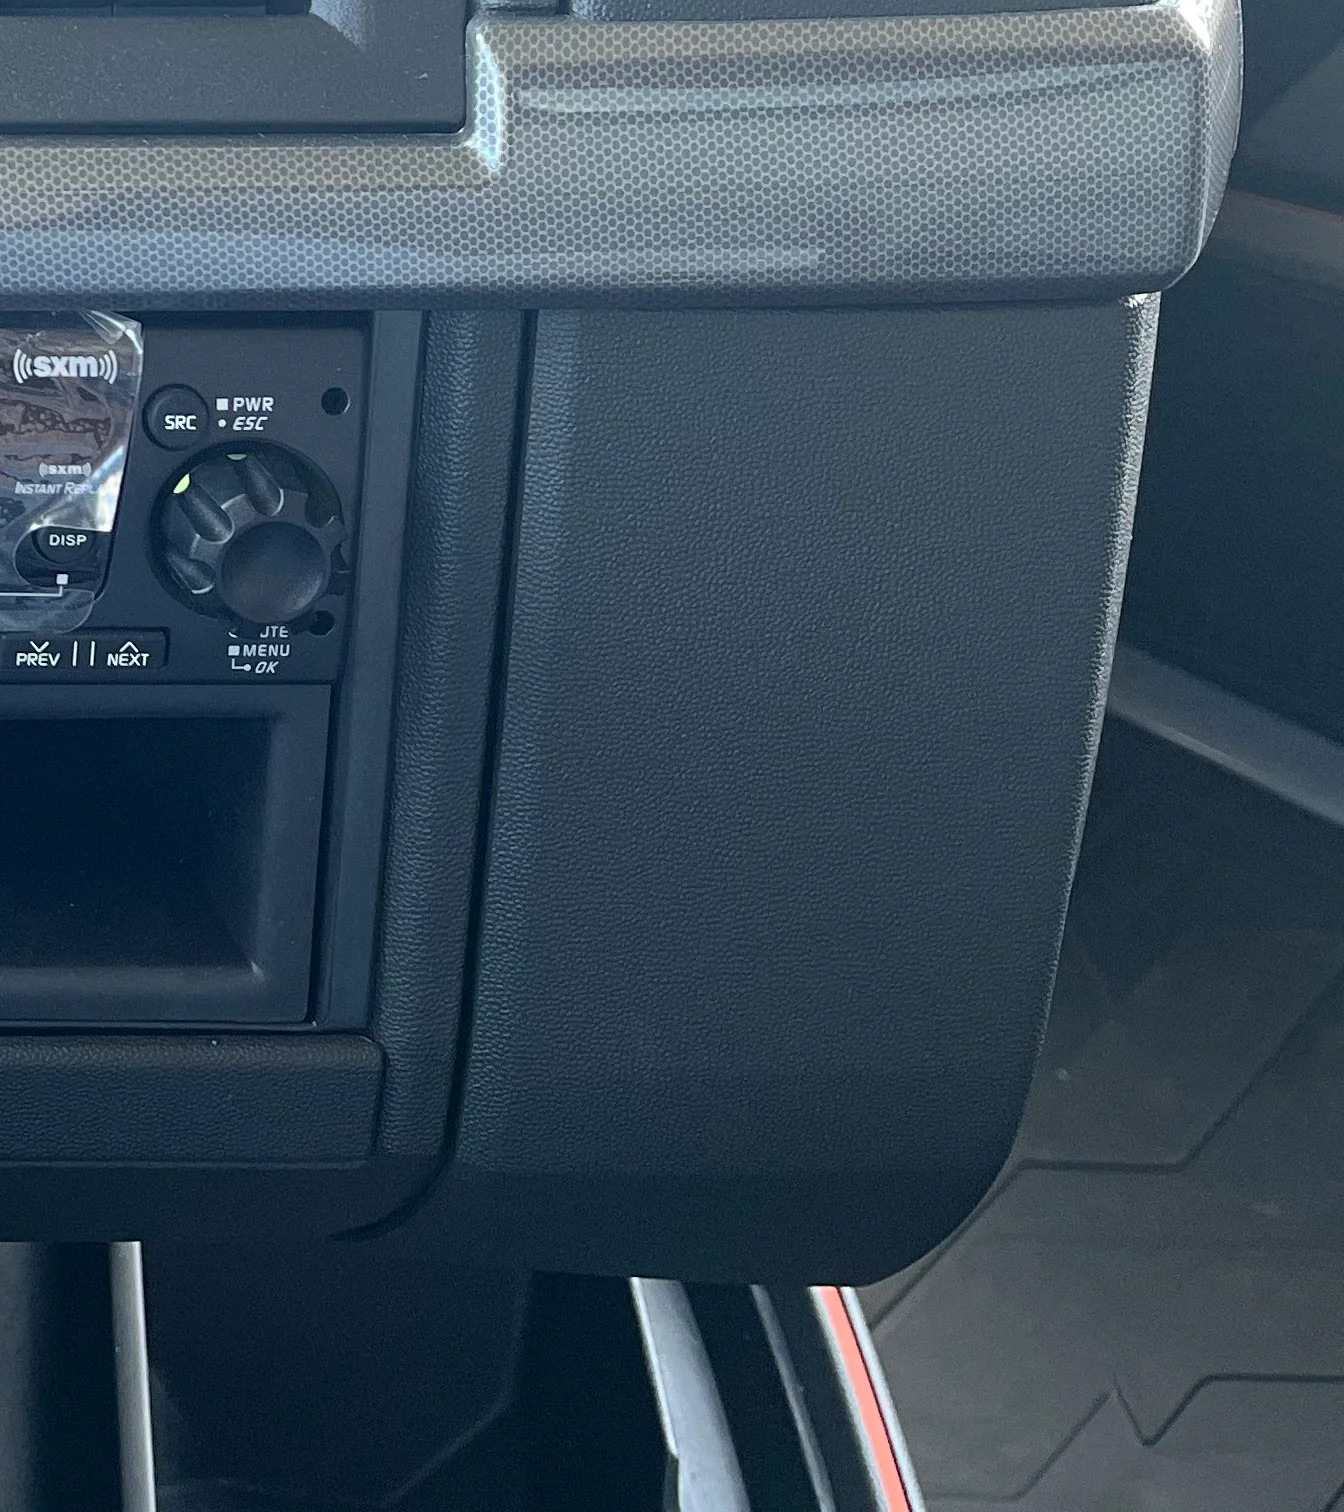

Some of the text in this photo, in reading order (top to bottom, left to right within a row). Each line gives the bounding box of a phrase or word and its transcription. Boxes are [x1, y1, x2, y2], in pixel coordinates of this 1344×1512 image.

[33, 354, 99, 378] sxm
[233, 397, 274, 412] PWR
[164, 415, 197, 431] SRC
[232, 417, 267, 432] ESC
[15, 481, 63, 494] INSTANT
[49, 534, 87, 546] DISP
[259, 625, 289, 638] UTE
[242, 644, 290, 657] MENU
[16, 653, 61, 667] PREV
[107, 653, 150, 667] NEXT
[255, 661, 279, 674] OK
